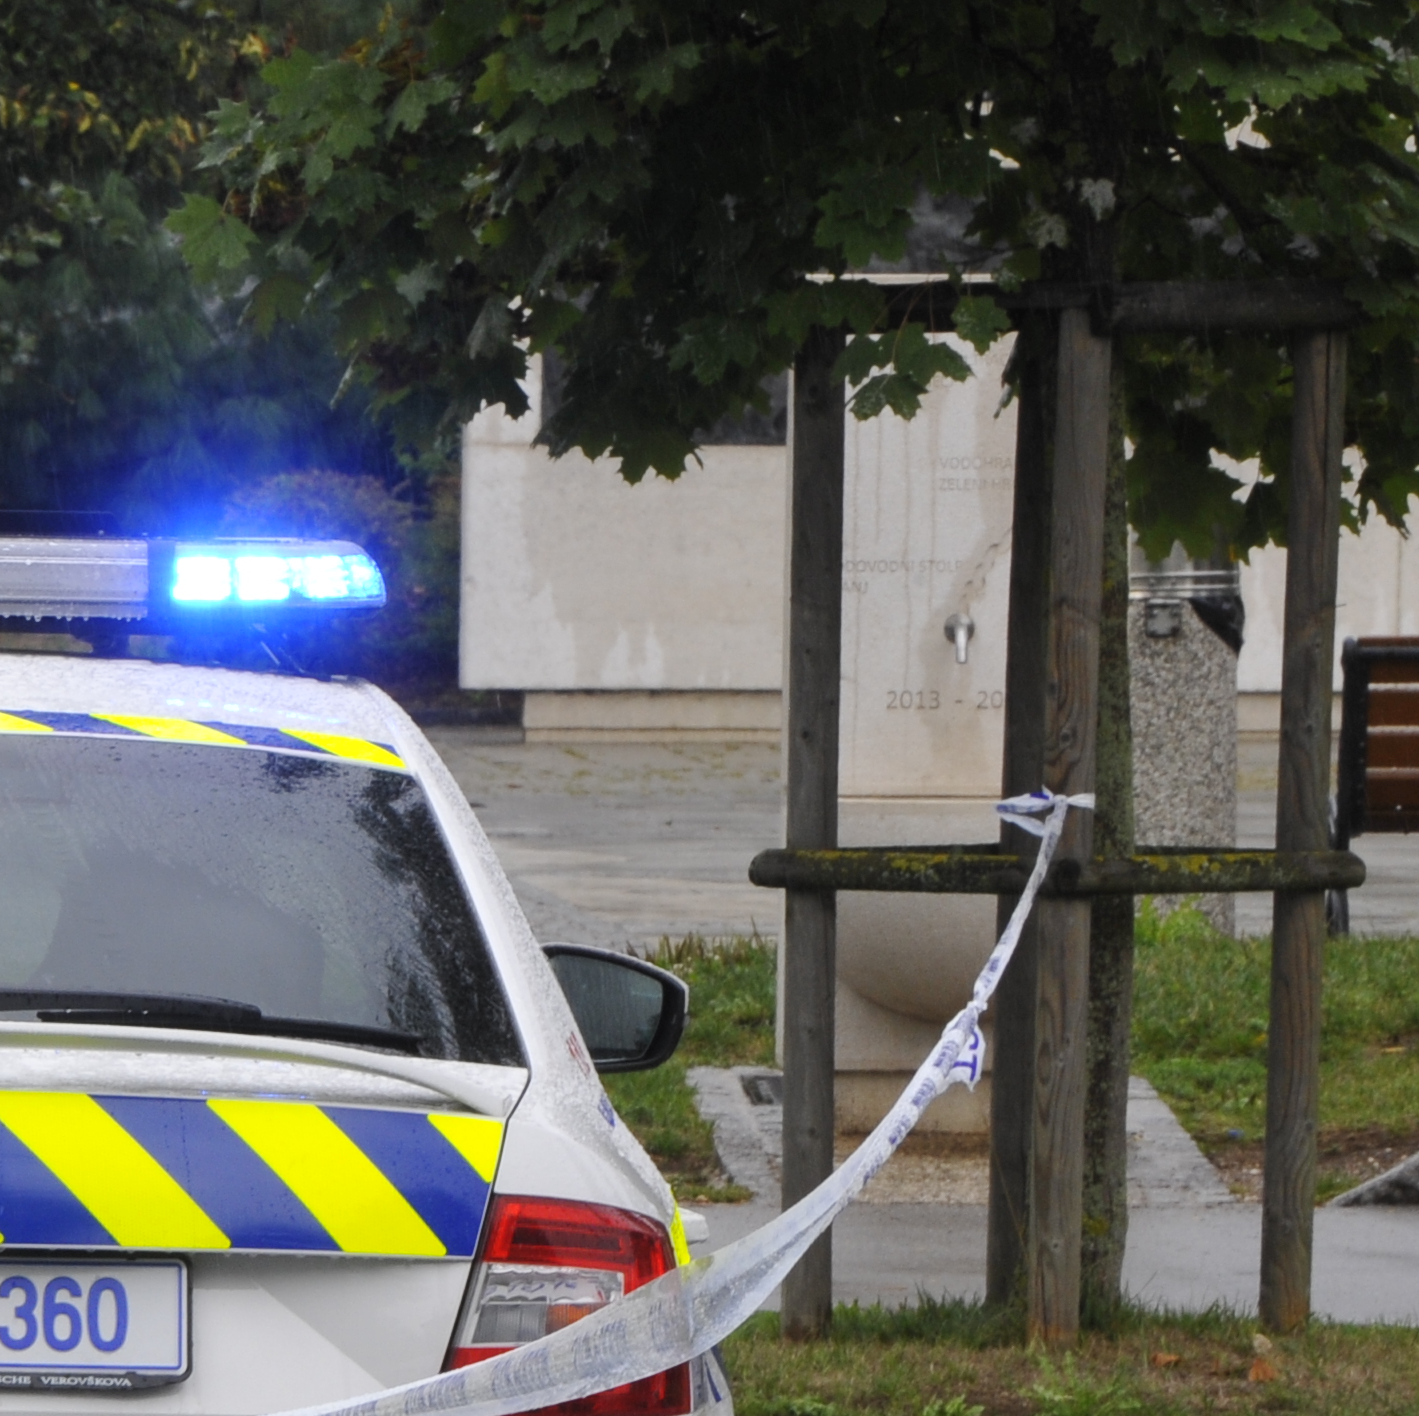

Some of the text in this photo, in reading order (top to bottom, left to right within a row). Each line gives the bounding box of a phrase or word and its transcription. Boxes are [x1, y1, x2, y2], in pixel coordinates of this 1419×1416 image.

[939, 457, 1013, 470] VODOHRA
[886, 689, 941, 710] 2013
[976, 690, 1003, 710] 20
[40, 1374, 133, 1387] VEROVŠKOVA
